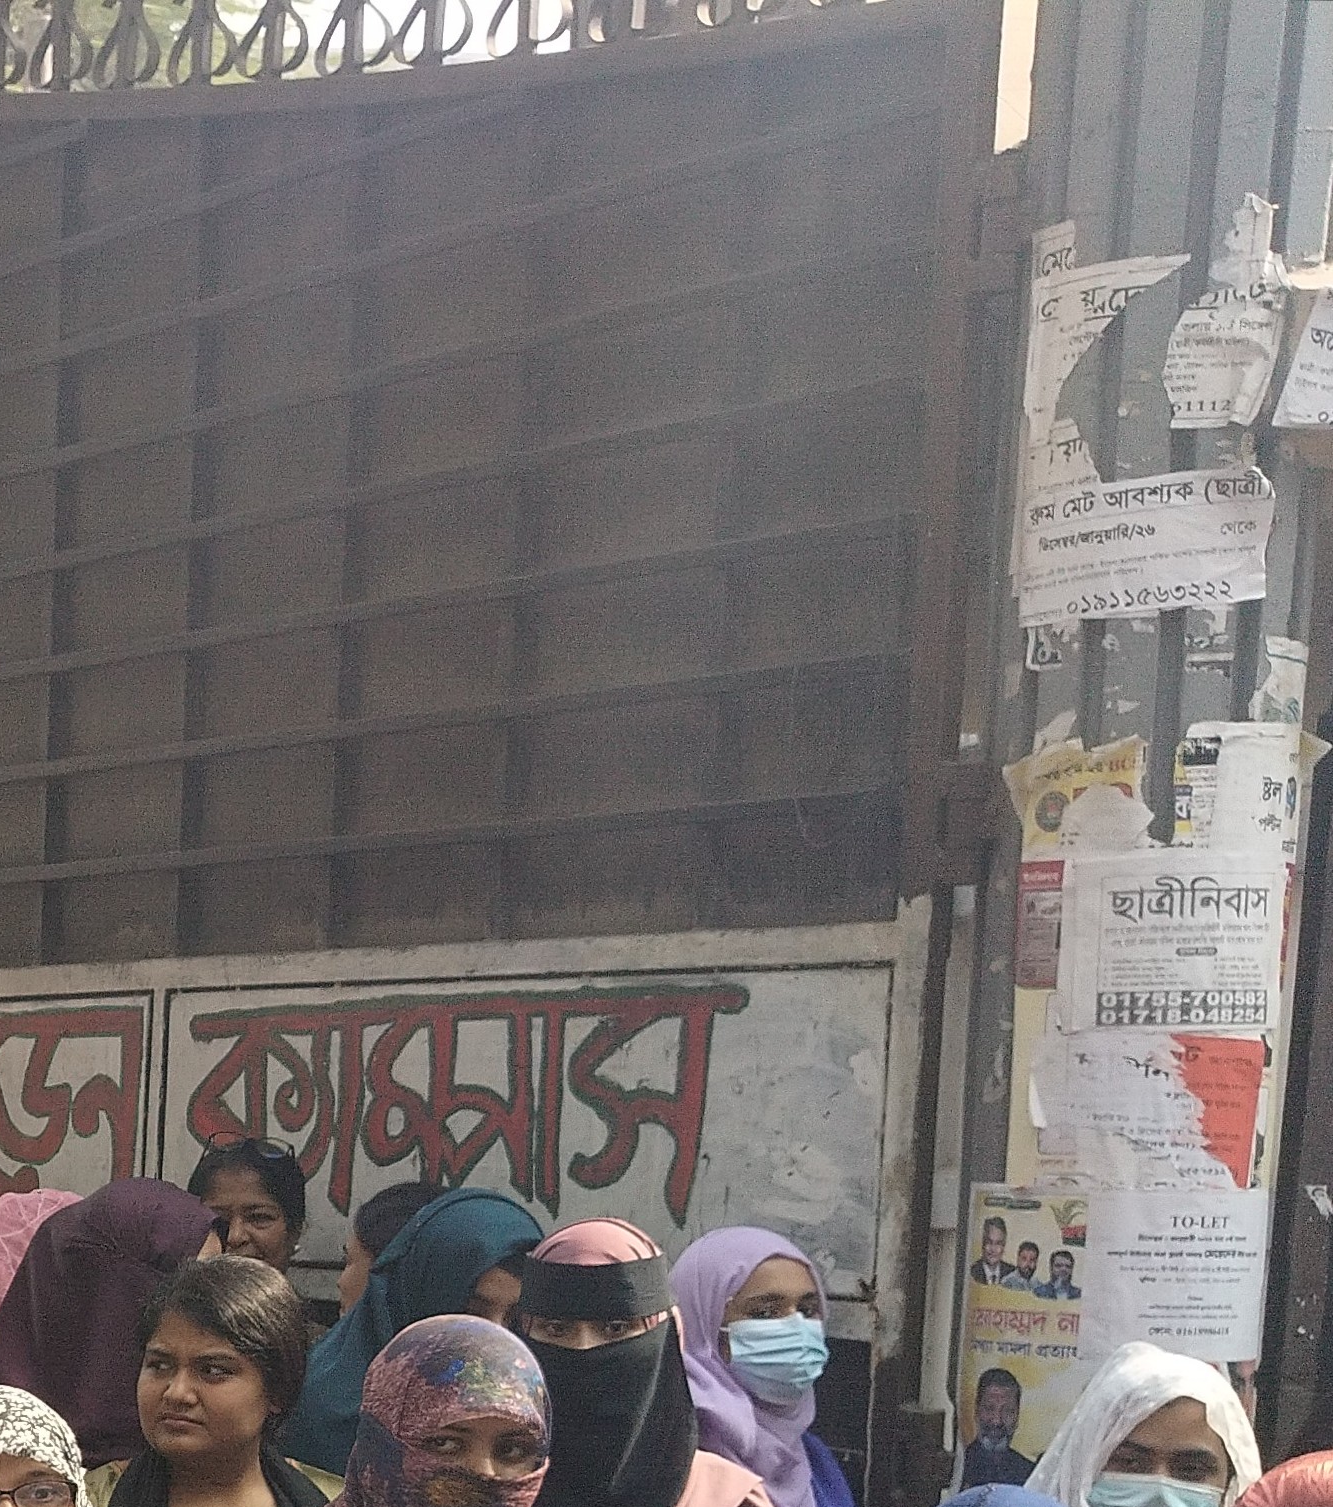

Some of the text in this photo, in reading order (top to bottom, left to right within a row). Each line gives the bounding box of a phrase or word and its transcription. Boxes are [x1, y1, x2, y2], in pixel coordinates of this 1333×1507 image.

[1063, 491, 1096, 519] মেট
[1103, 480, 1194, 509] আবশ্যক
[1108, 876, 1270, 924] ছাত্রীনিবাস
[1170, 1216, 1230, 1229] TO-LET
